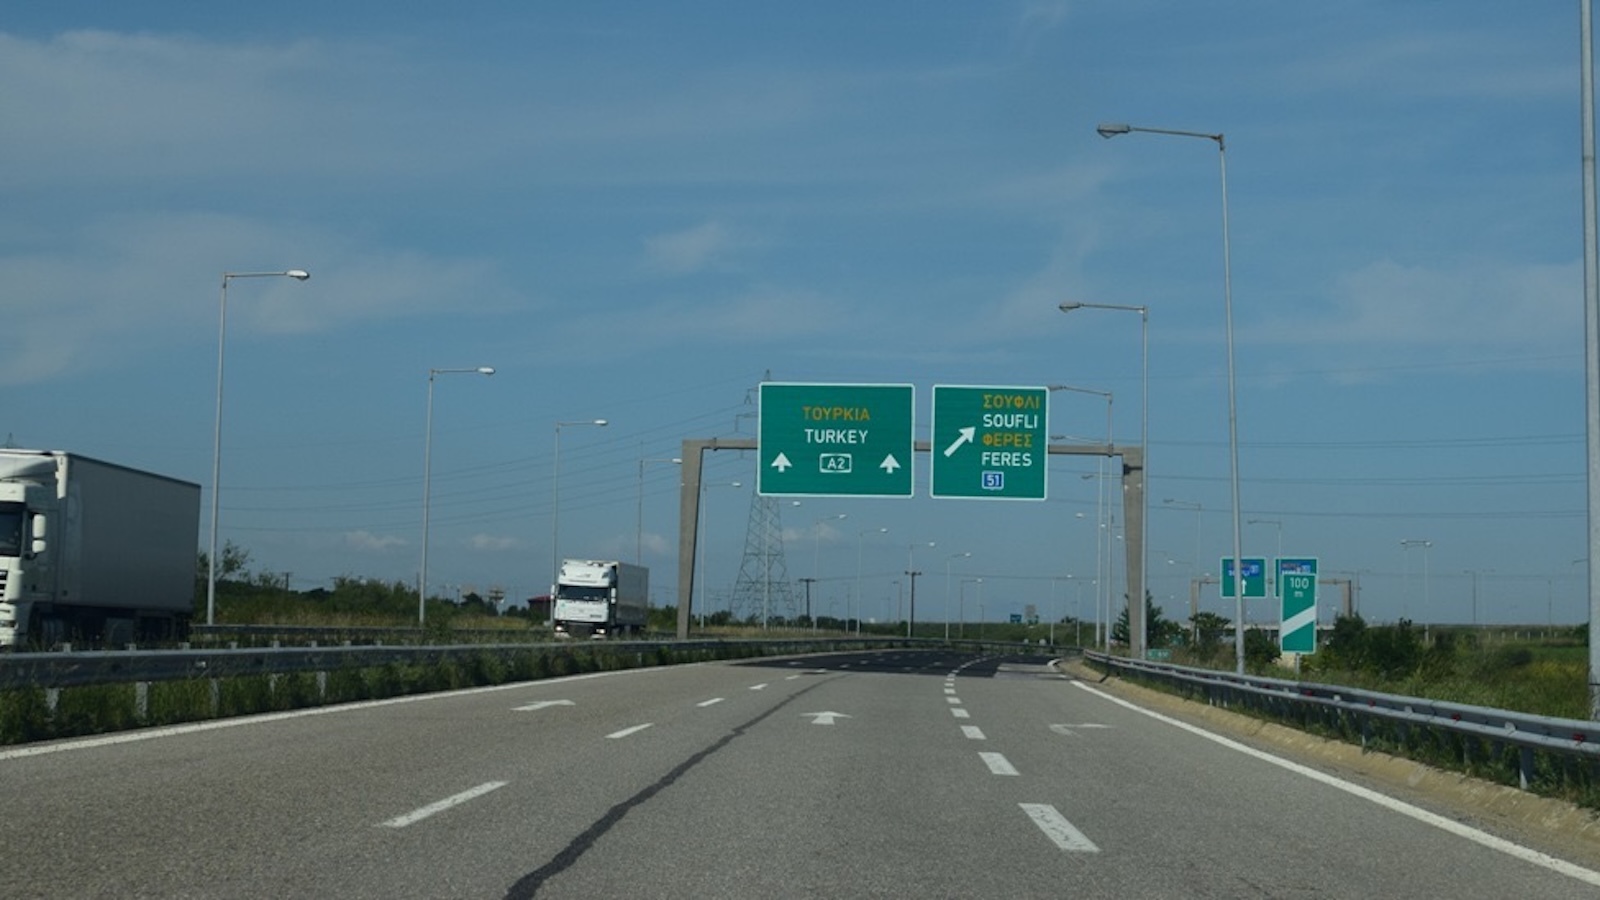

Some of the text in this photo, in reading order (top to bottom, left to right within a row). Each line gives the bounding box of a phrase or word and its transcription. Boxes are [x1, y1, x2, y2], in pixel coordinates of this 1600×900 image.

[983, 395, 1040, 409] ΣΟΥΦΛΙ
[802, 406, 870, 421] ΤΟΥΡΚΙΑ
[983, 414, 1038, 429] SOUFLI
[804, 429, 868, 444] TURKEY
[982, 433, 1032, 448] ΦΕΡΕΣ
[827, 457, 844, 469] A2
[982, 452, 1032, 467] FERES
[986, 475, 999, 486] 51
[1290, 578, 1309, 589] 100
